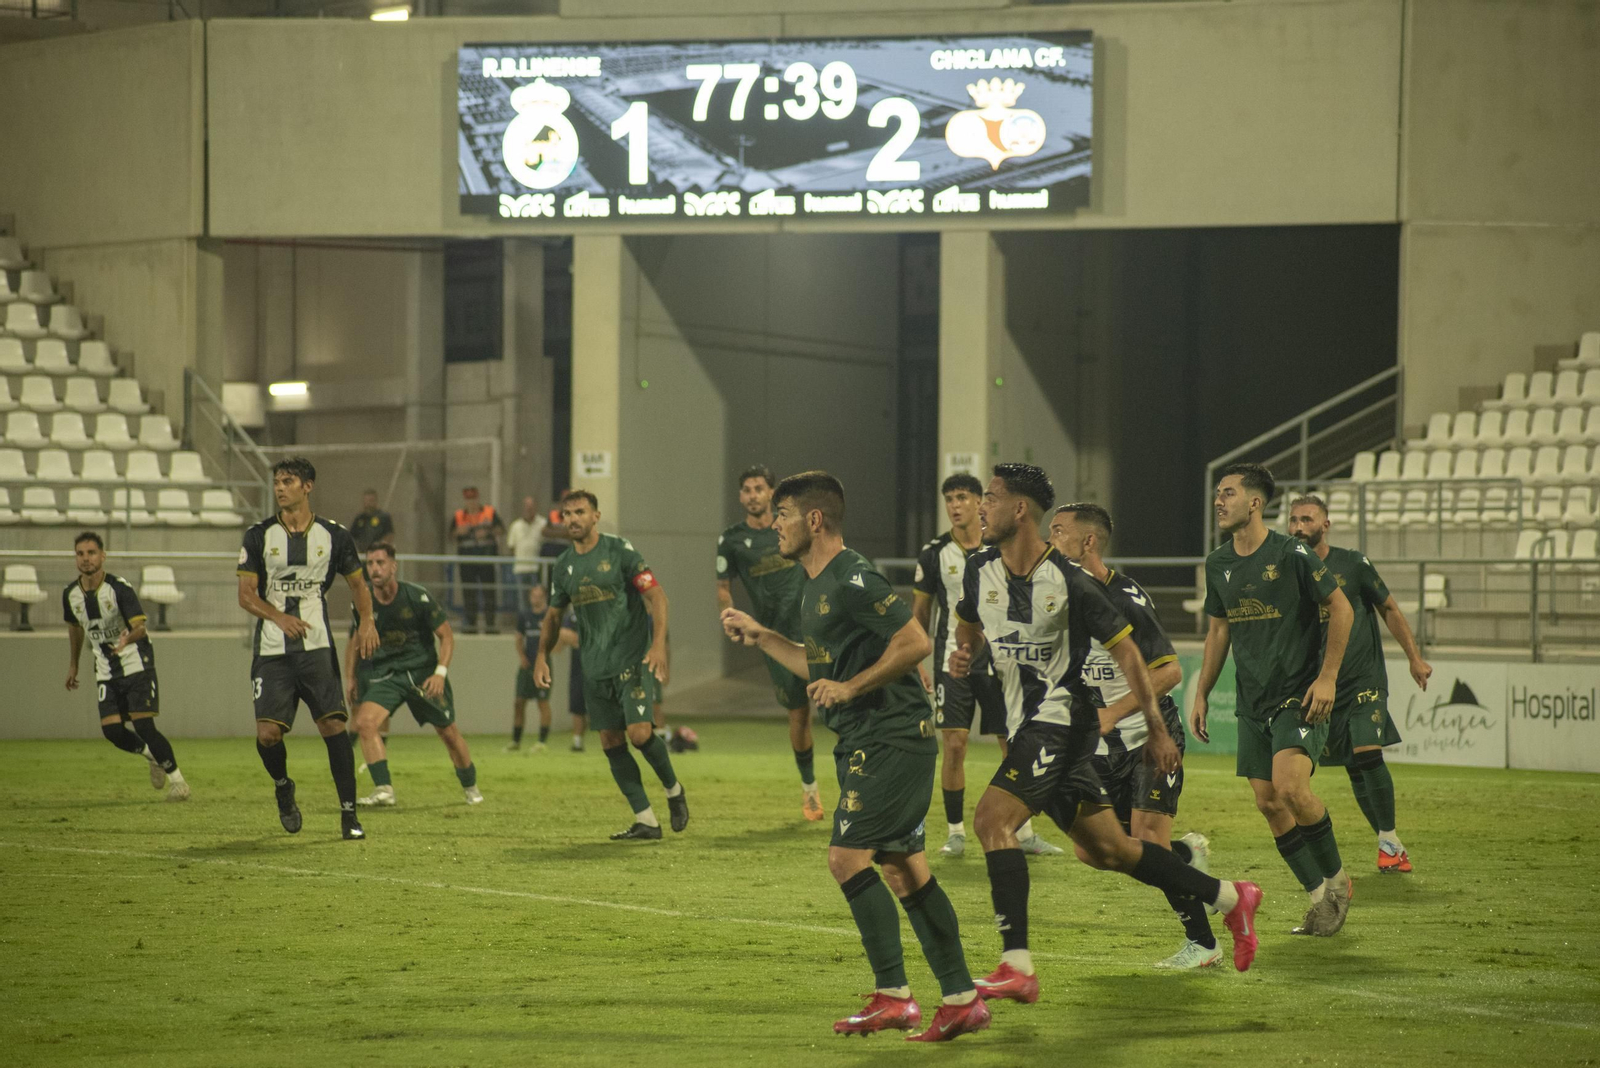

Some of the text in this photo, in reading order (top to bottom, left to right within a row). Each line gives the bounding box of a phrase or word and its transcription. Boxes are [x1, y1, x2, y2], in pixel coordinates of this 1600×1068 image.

[930, 46, 1067, 70] CHICLANA CF.
[685, 60, 858, 122] 77:39
[610, 101, 649, 185] 1
[866, 97, 921, 182] 2
[252, 677, 263, 700] 3
[1511, 685, 1596, 728] Hospital
